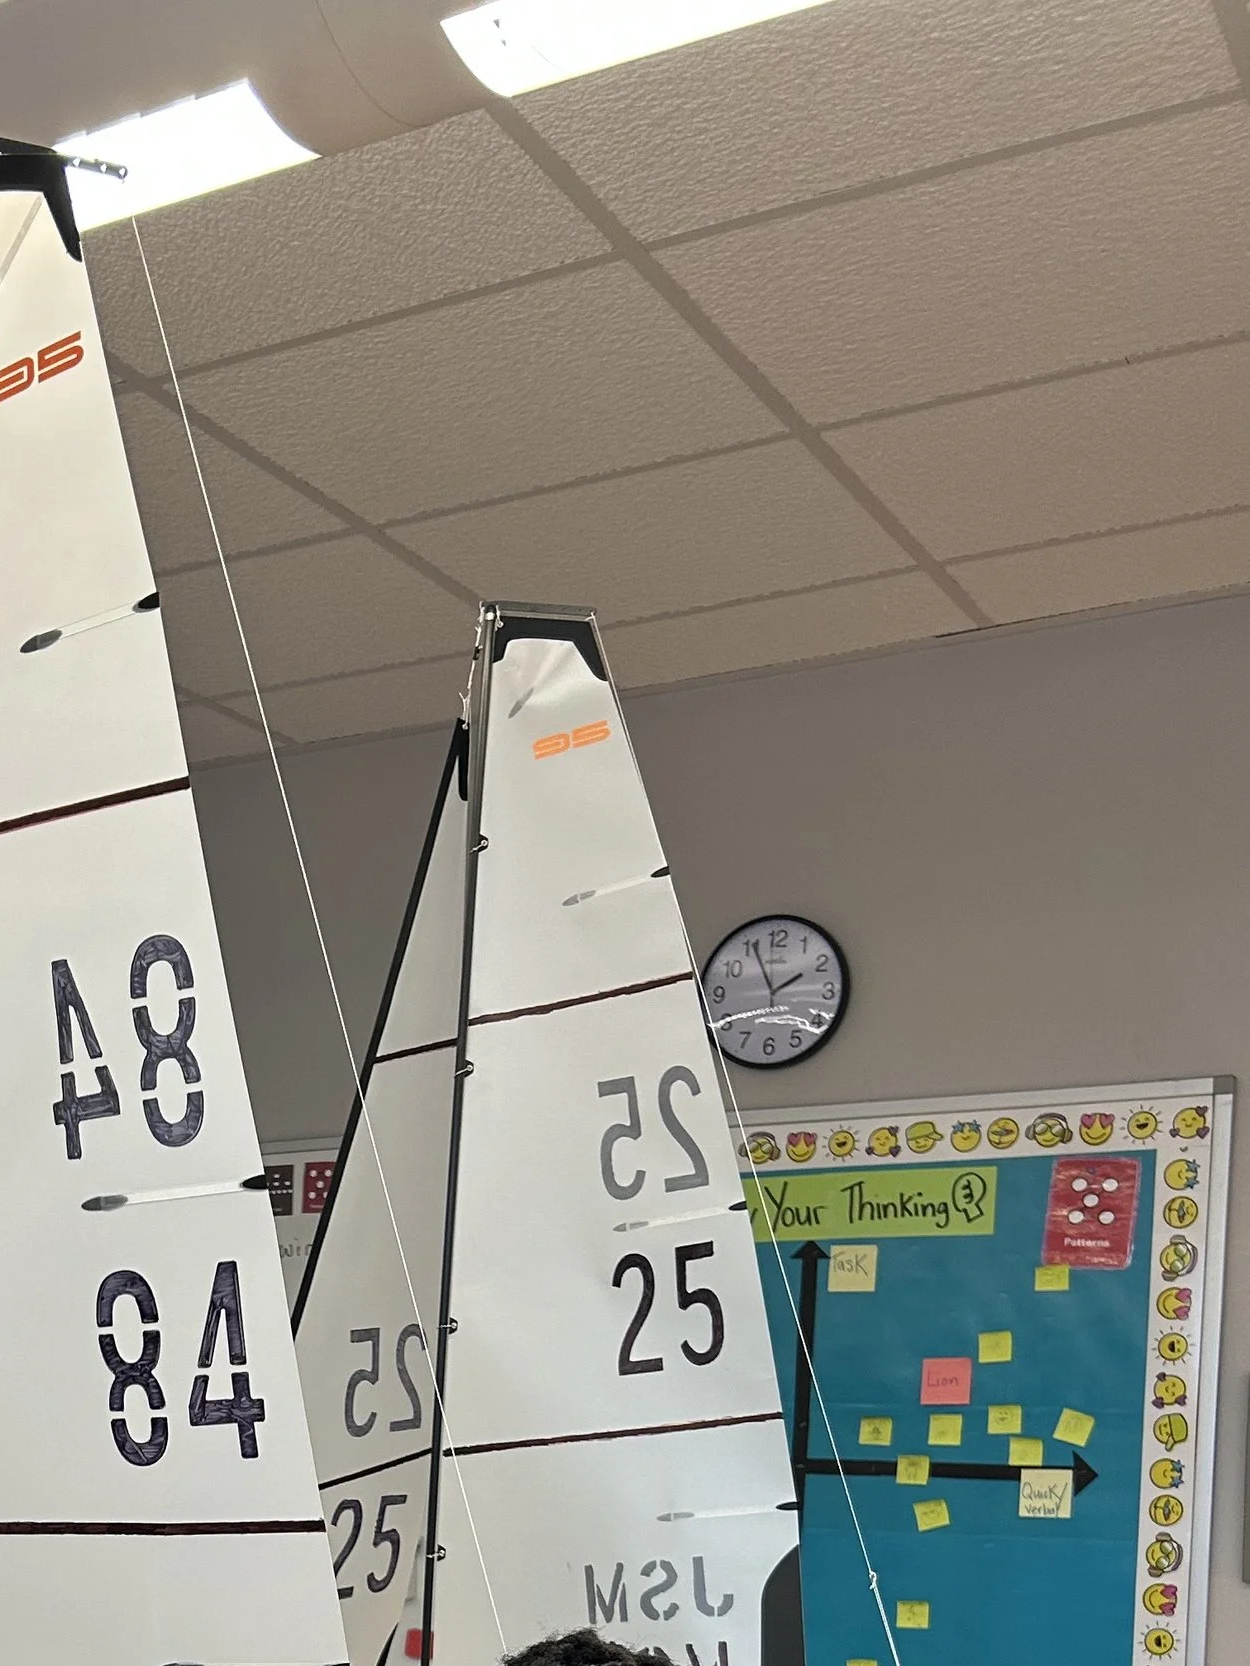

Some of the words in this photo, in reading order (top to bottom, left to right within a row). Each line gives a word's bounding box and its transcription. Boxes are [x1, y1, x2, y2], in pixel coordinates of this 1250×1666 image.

[532, 719, 611, 760] 95
[768, 929, 788, 948] 12
[801, 936, 807, 954] 1
[722, 960, 742, 979] 10
[815, 954, 829, 972] 2
[713, 985, 726, 1004] 9
[822, 981, 835, 1000] 3
[739, 1031, 752, 1048] 7
[763, 1037, 776, 1056] 6
[789, 1030, 802, 1048] 5
[763, 1180, 828, 1234] Your
[840, 1180, 950, 1229] Thinking
[1064, 1238, 1110, 1248] Patterns
[612, 1240, 724, 1376] 25
[96, 1260, 265, 1466] 84
[927, 1370, 959, 1388] Lion
[1024, 1502, 1059, 1516] verbal
[330, 1494, 408, 1601] 25
